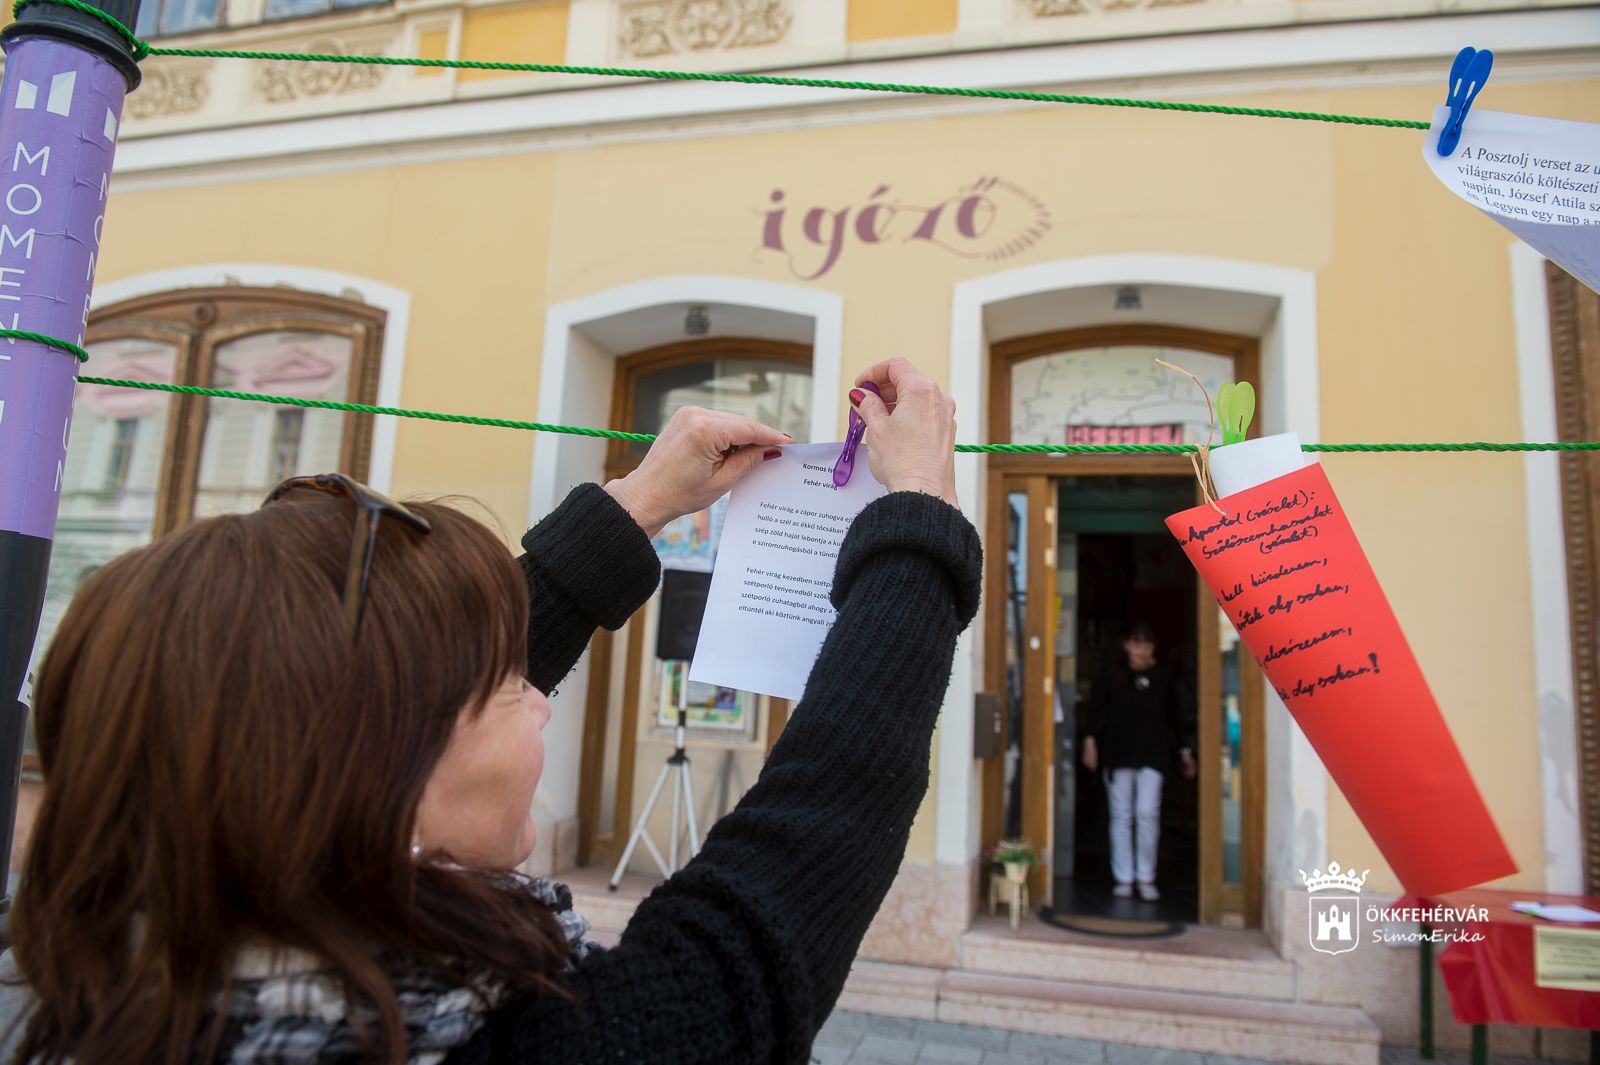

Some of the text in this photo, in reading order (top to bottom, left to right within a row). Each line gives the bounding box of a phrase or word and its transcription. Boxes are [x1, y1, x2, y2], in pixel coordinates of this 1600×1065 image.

[1461, 146, 1472, 159] A
[1477, 147, 1530, 169] Posztolj
[1533, 157, 1571, 171] verset
[1574, 163, 1590, 174] az
[1457, 164, 1599, 194] világraszóló költészeti
[1462, 180, 1505, 198] napján,
[1508, 188, 1549, 204] József
[1551, 195, 1586, 210] Attila
[1485, 196, 1528, 216] Legyen
[1532, 209, 1554, 223] egy
[1557, 214, 1580, 225] nap
[752, 177, 997, 282] igéző
[802, 463, 827, 473] Kormos
[803, 478, 821, 488] Fehér
[759, 501, 778, 510] Fehér
[778, 506, 794, 514] virág
[800, 509, 817, 518] zápor
[818, 513, 844, 522] zuhogva
[757, 514, 773, 522] holló
[779, 518, 792, 526] szél
[800, 522, 815, 530] ékkő
[816, 524, 844, 535] tócsában
[754, 527, 769, 536] szép
[769, 530, 783, 538] zöld
[784, 532, 800, 541] haját
[801, 535, 826, 545] lebontja
[757, 541, 813, 555] sziromzuhogásból
[746, 567, 765, 576] Fehér
[765, 571, 781, 580] virág
[782, 574, 813, 584] kezedben
[743, 580, 773, 590] szétporló
[774, 585, 813, 597] tenyeredből
[741, 592, 771, 602] szétporló
[771, 598, 807, 609] zuhatagból
[807, 604, 827, 614] ahogy
[738, 605, 764, 614] eltüntél
[775, 610, 801, 621] köztünk
[801, 617, 825, 626] angyali
